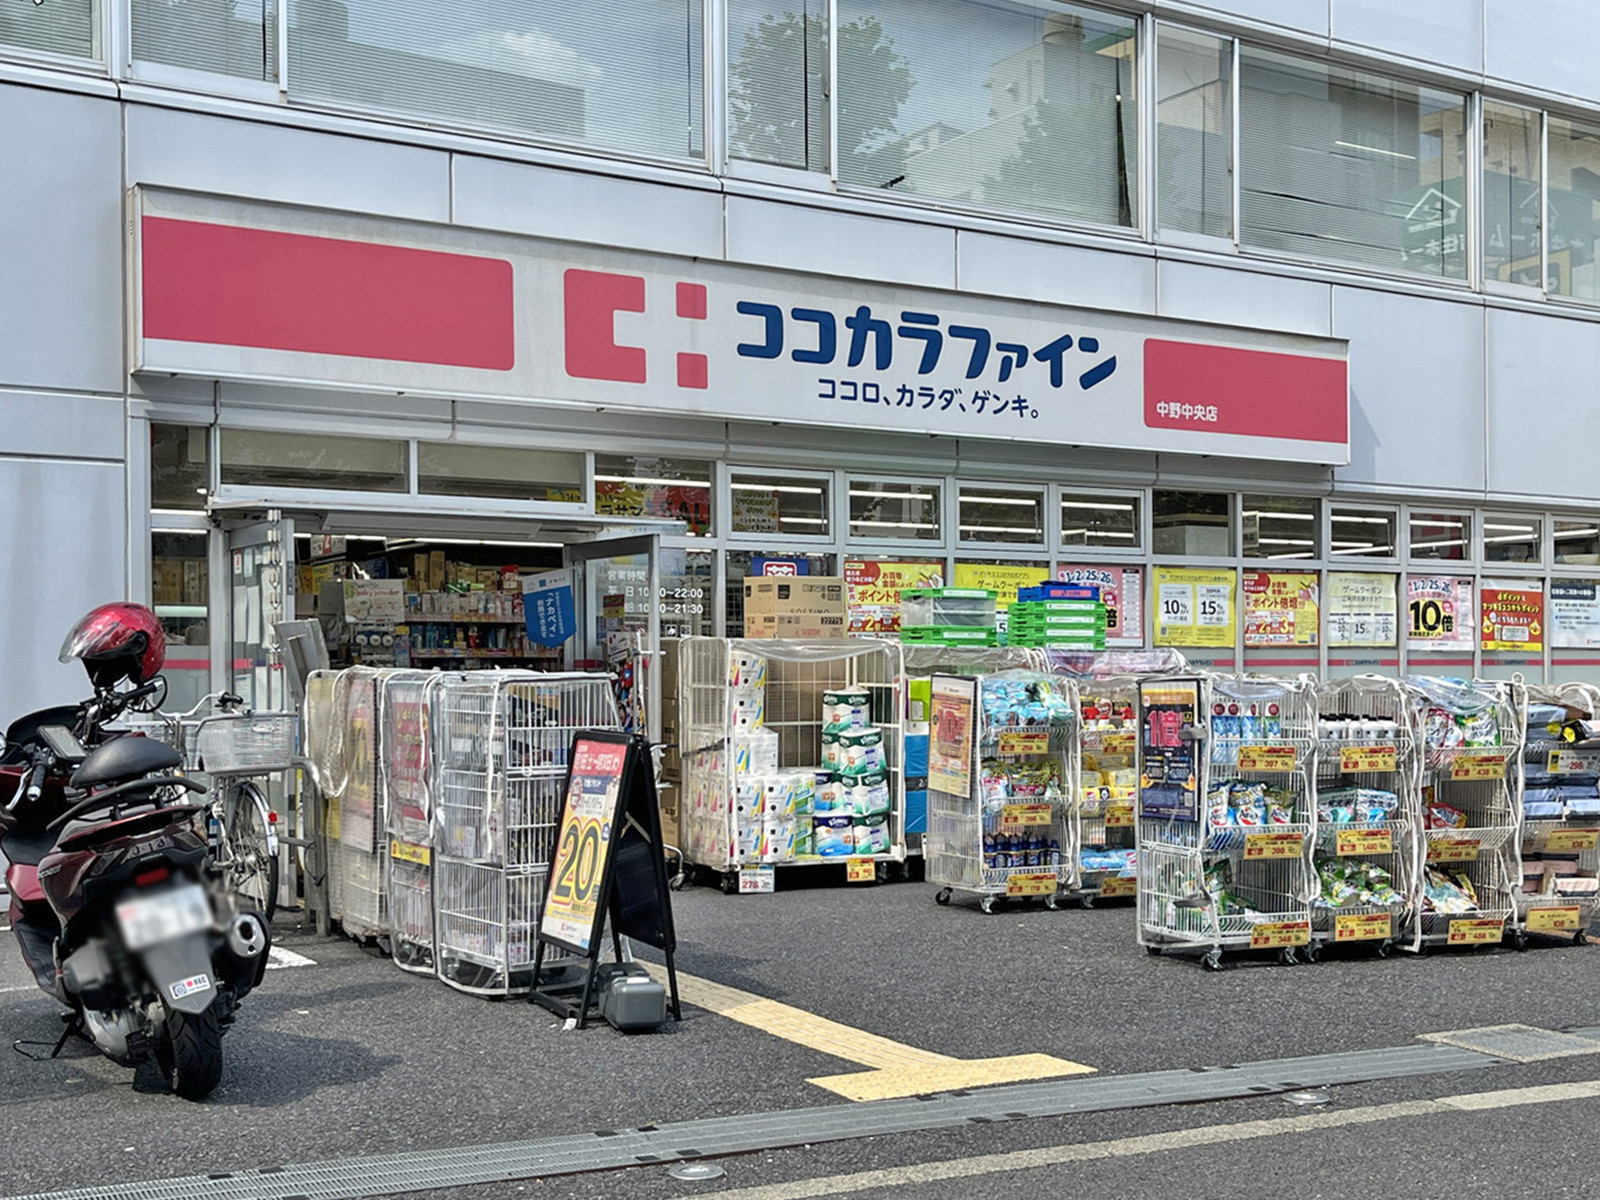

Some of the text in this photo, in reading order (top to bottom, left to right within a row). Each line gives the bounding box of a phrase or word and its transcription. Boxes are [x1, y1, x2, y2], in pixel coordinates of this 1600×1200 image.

[736, 301, 1117, 390] ココカラファイン
[818, 378, 1039, 420] ココロ、カラダ、ゲンキ。
[1156, 400, 1218, 421] 中野中央店
[607, 569, 646, 582] 営業時間
[626, 587, 634, 596] 日
[638, 587, 703, 599] 100~22:00
[638, 603, 703, 614] 100~21:30
[1164, 600, 1180, 614] 10
[1201, 601, 1217, 615] 15
[1355, 623, 1366, 634] 15
[554, 822, 602, 901] 20
[742, 881, 759, 889] 278
